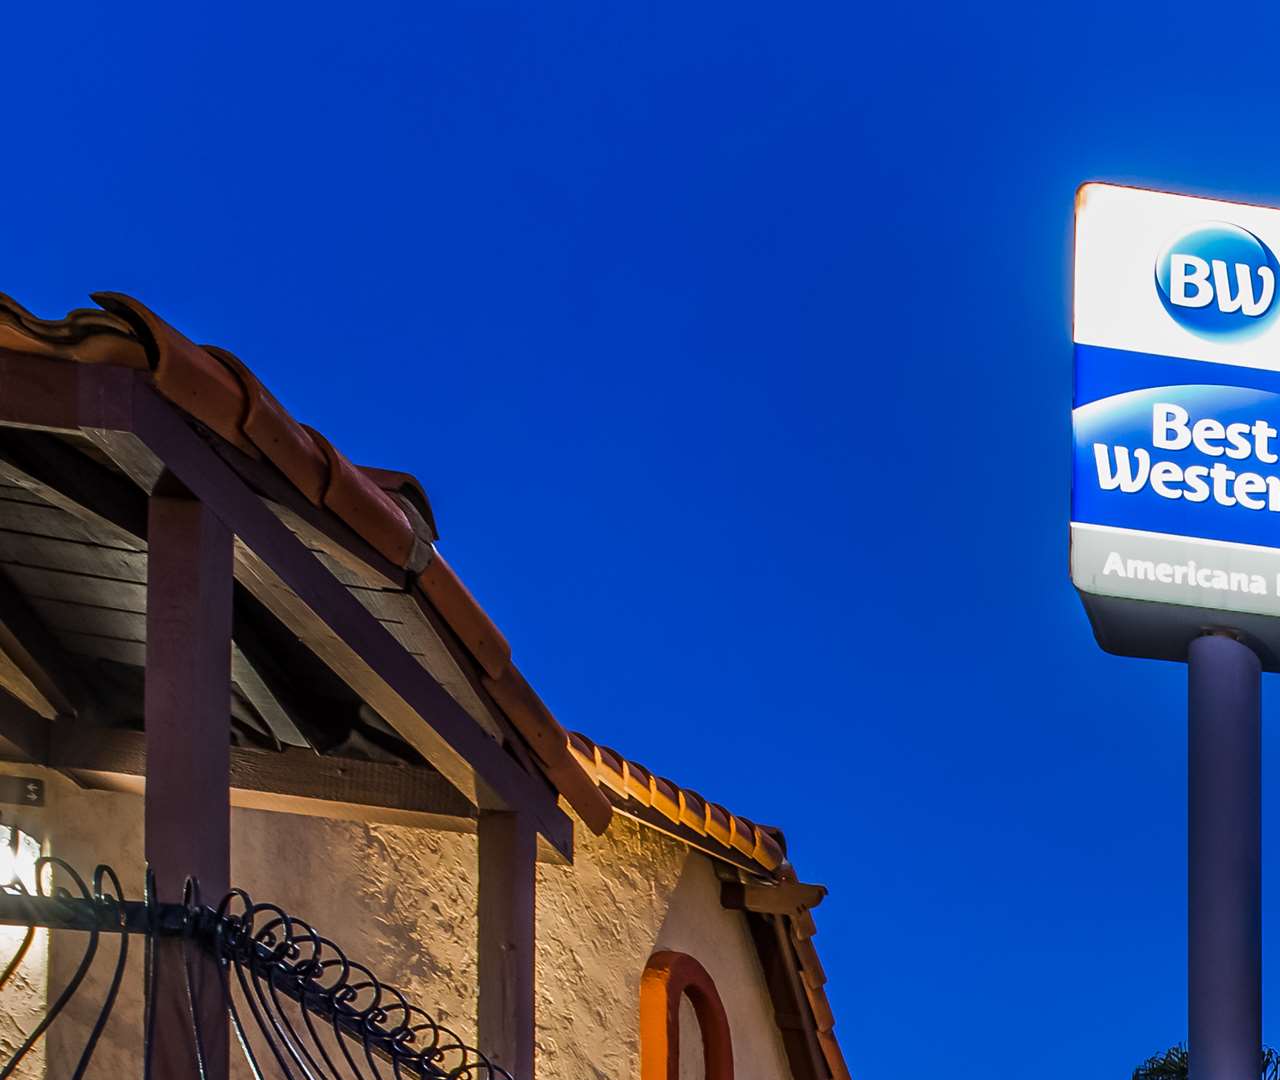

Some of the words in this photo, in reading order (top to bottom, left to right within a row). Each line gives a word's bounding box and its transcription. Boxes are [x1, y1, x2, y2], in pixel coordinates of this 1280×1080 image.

[1170, 253, 1276, 317] BW
[1153, 402, 1278, 463] Best
[1102, 551, 1268, 595] Americana
